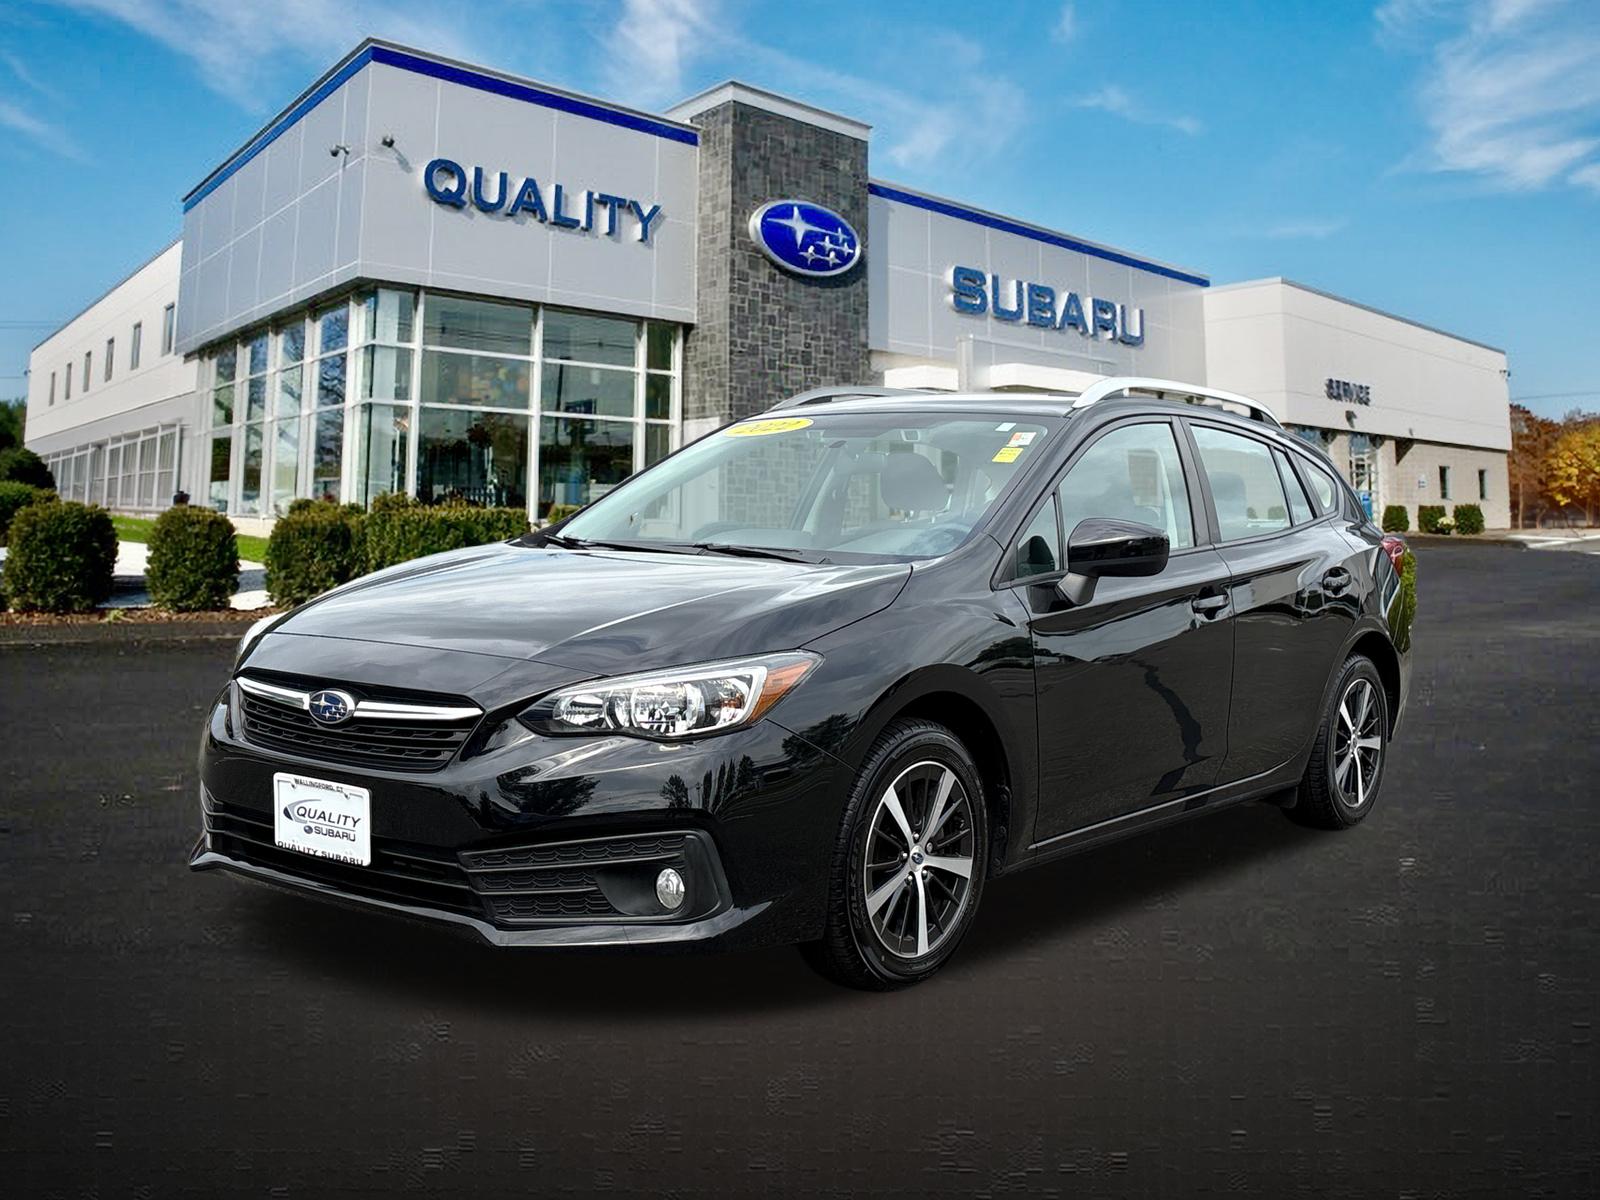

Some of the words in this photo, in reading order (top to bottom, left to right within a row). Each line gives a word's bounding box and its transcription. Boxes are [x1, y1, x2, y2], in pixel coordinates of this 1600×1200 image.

[424, 158, 662, 243] QUALITY
[951, 265, 1145, 346] SUBARU
[296, 806, 361, 828] QUALITY
[314, 825, 356, 842] SUBARU
[276, 840, 318, 857] QUALITY
[321, 850, 364, 867] SUBARU
